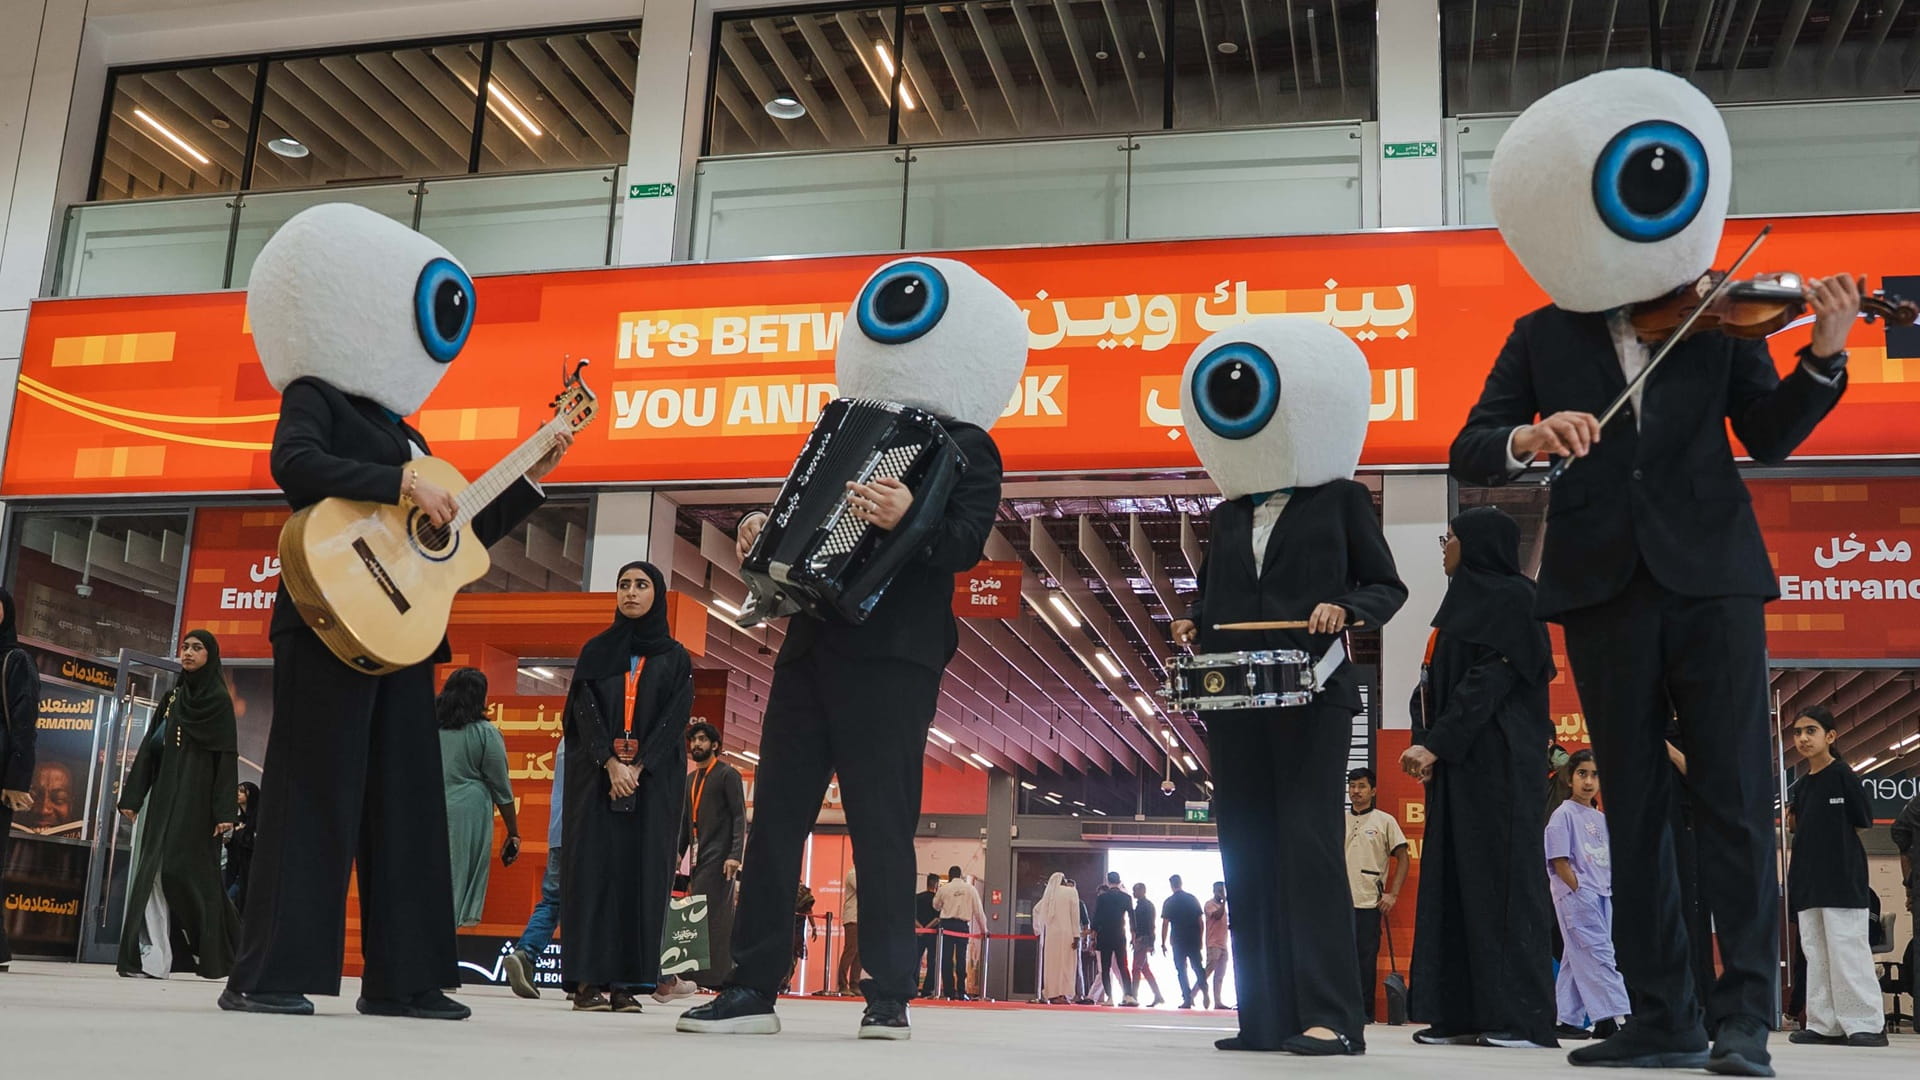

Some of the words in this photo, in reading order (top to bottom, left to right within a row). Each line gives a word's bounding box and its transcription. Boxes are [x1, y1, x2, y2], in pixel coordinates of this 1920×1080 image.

[1022, 289, 1177, 351] وبين
[618, 318, 699, 359] It's
[711, 311, 843, 356] BETW
[726, 382, 840, 425] AND
[1814, 532, 1912, 569] مدخل
[970, 577, 1001, 592] مخرج
[1779, 575, 1920, 600] Entranc
[220, 587, 278, 609] Entr
[971, 594, 998, 605] Exit
[37, 718, 94, 731] RMATION
[487, 702, 564, 738] ينك
[5, 893, 79, 916] الاستعلامات
